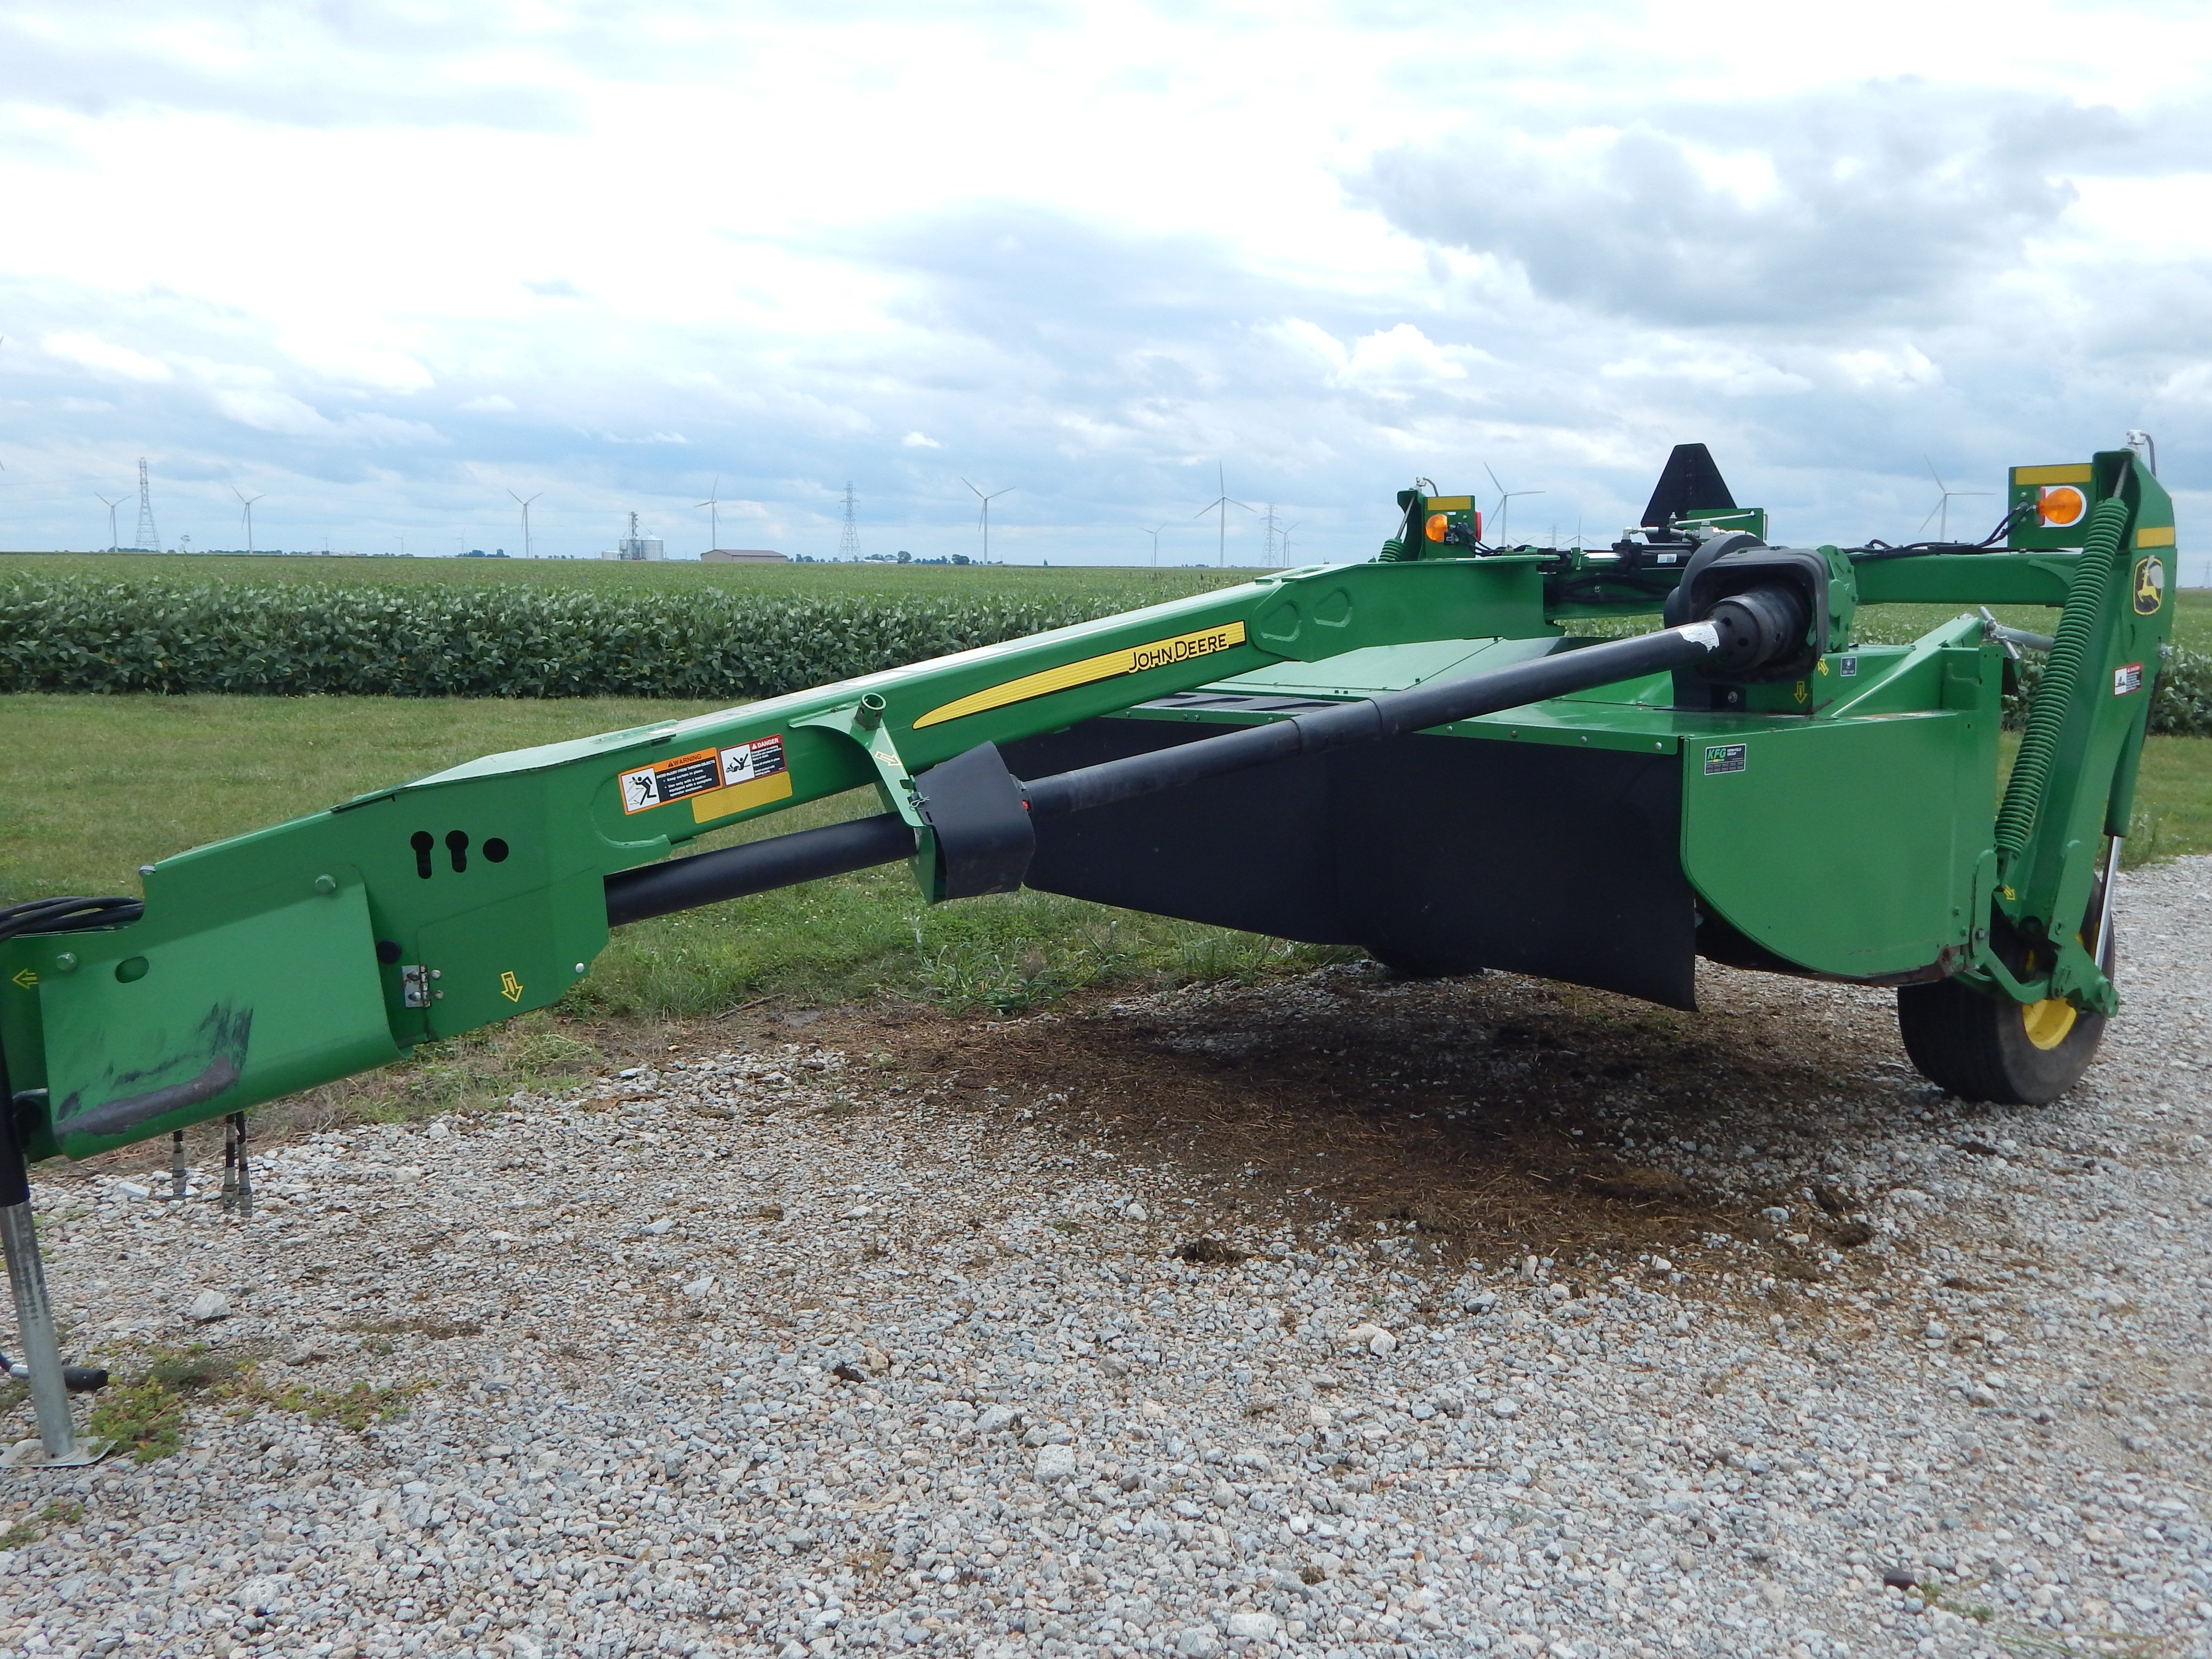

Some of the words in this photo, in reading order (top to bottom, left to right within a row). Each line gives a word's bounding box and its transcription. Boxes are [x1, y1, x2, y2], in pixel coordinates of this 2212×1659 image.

[1129, 646, 1173, 671] JOHN
[1175, 633, 1227, 659] DEERE
[757, 738, 779, 748] DANGER
[1707, 747, 1727, 759] KFG
[673, 754, 702, 766] WARNING
